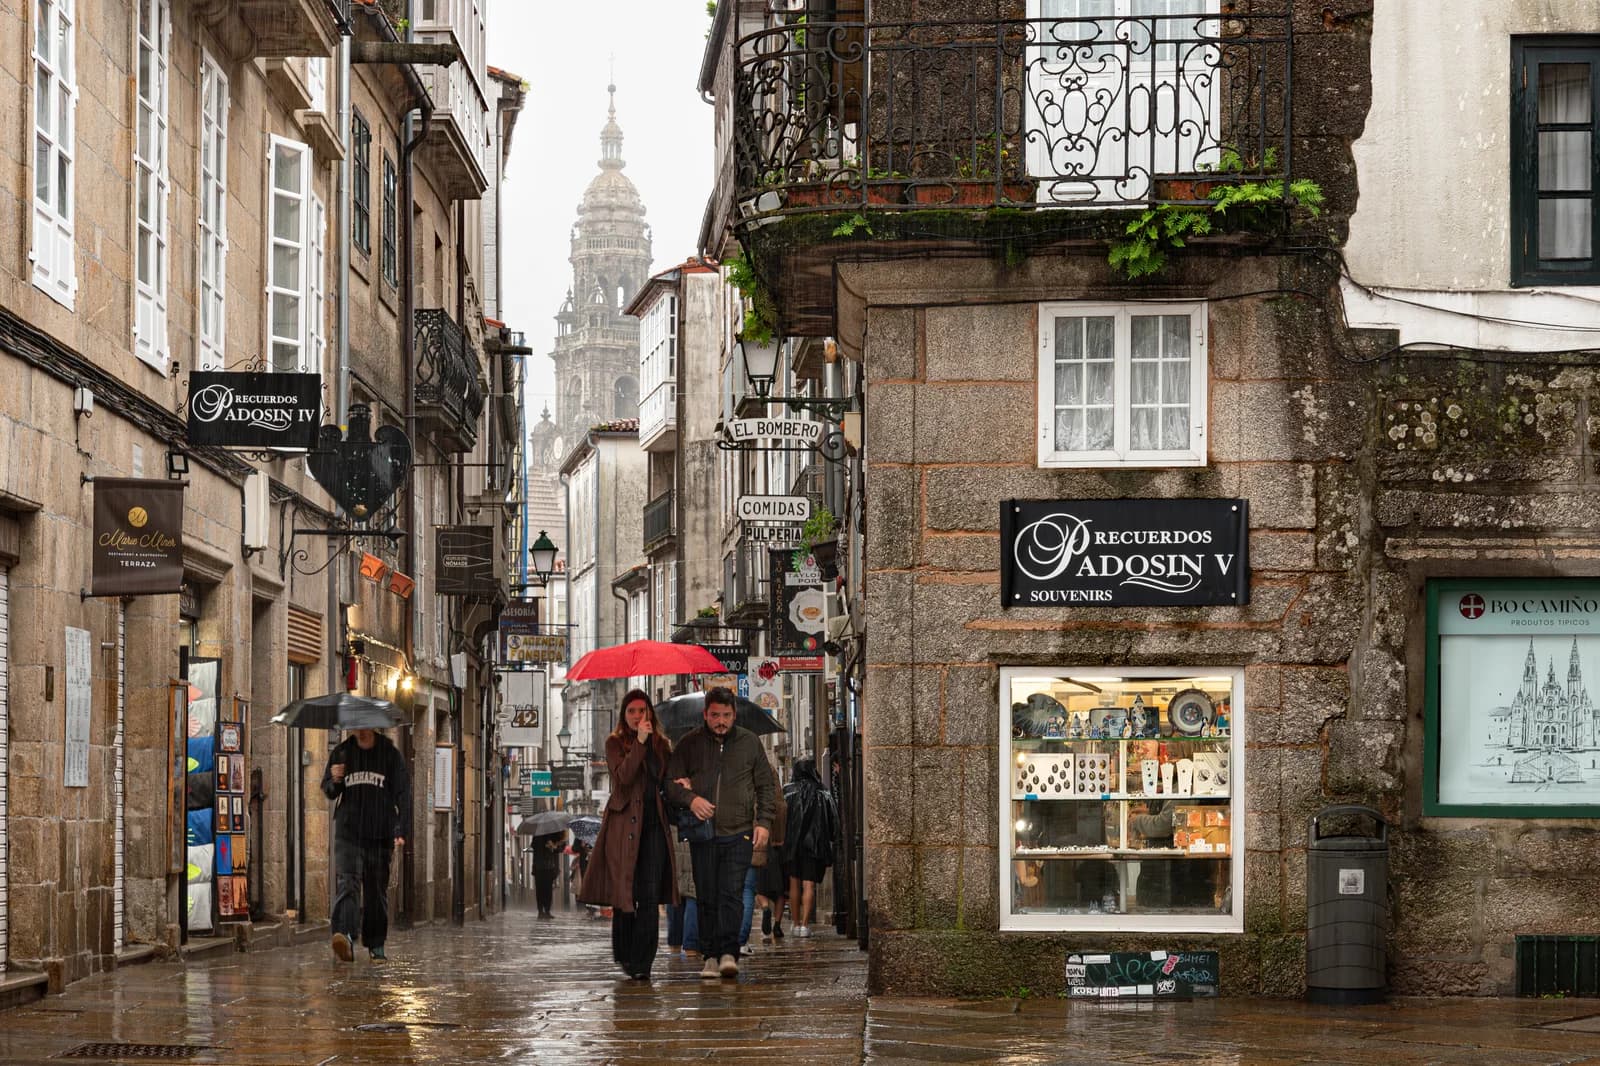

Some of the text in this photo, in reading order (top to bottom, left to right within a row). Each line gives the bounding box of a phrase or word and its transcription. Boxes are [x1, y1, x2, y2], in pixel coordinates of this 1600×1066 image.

[235, 394, 298, 404] RECUERDOS
[192, 384, 315, 432] PADOSIN IV
[734, 421, 819, 438] EL BOMBERO
[742, 501, 805, 516] COMIDAS
[745, 527, 801, 540] PULPERIA
[1094, 530, 1212, 545] RECUERDOS
[1014, 513, 1235, 593] PADOSIN V
[120, 560, 156, 568] TERRAZA
[1030, 589, 1113, 602] SOUVENIRS
[1491, 595, 1598, 614] BO CAMIÑO
